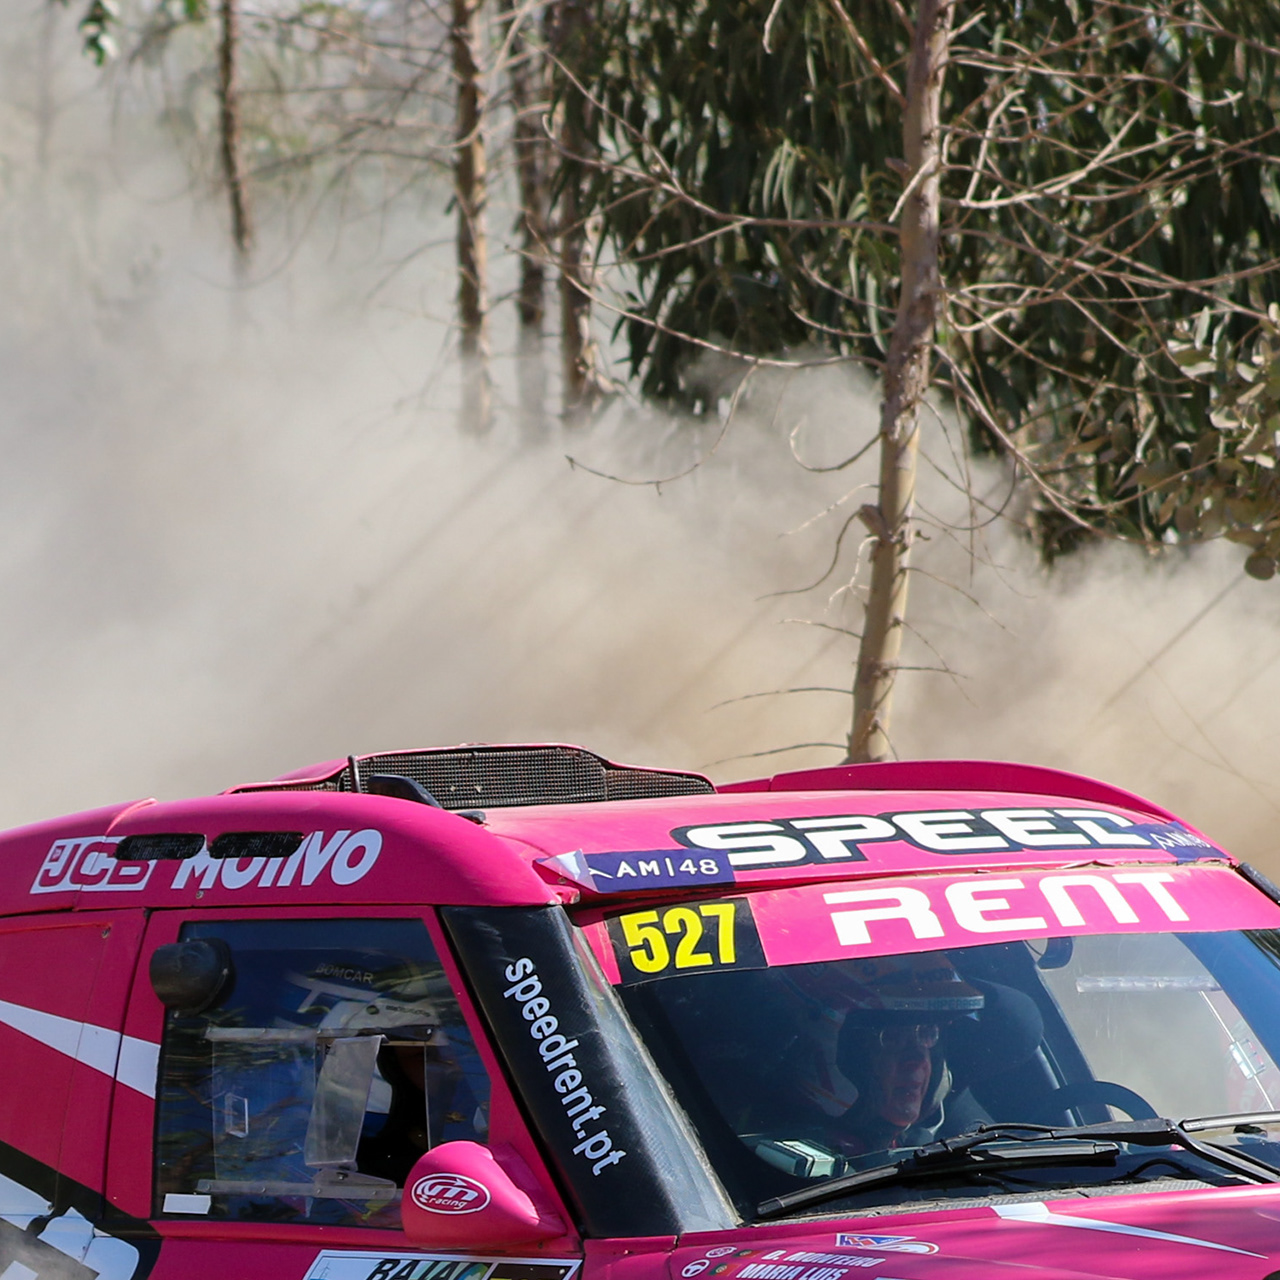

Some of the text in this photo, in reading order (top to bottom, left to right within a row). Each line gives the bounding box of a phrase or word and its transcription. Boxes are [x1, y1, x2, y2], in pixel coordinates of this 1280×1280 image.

[685, 808, 1153, 867] SPEED
[623, 901, 738, 974] 527
[821, 871, 1191, 947] RENT
[503, 956, 627, 1177] speedrent.pt
[736, 1263, 805, 1280] MARIA
[783, 1251, 886, 1268] MONTEIRO
